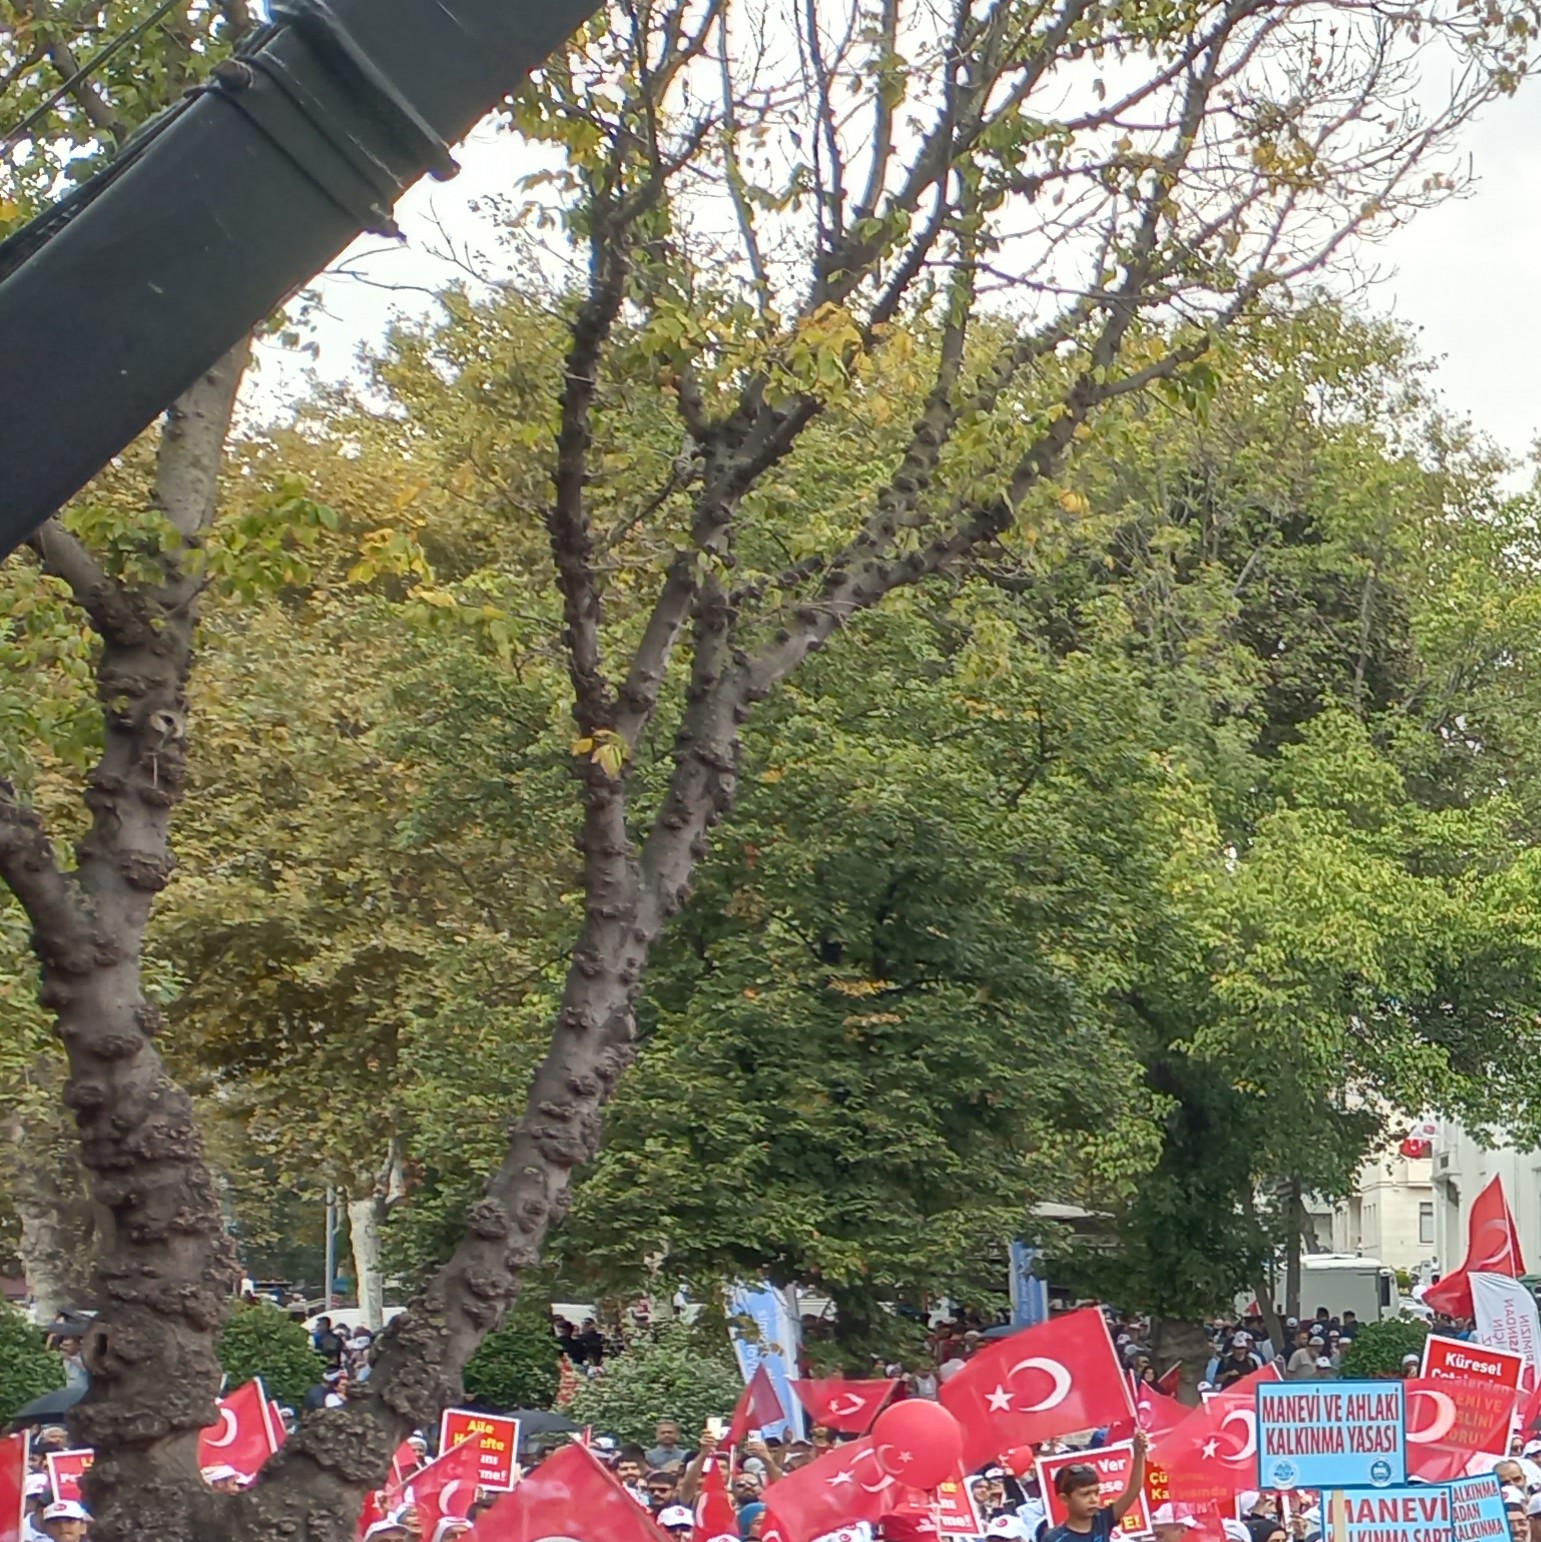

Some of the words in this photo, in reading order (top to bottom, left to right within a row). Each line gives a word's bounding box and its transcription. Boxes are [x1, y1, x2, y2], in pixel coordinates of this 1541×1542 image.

[1445, 1352, 1503, 1376] Küresel
[1262, 1387, 1320, 1423] MANEVİ
[1325, 1394, 1343, 1422] VE
[1346, 1387, 1399, 1421] AHLAKİ
[1266, 1426, 1344, 1455] KALKINMA
[1349, 1425, 1397, 1453] YASASI
